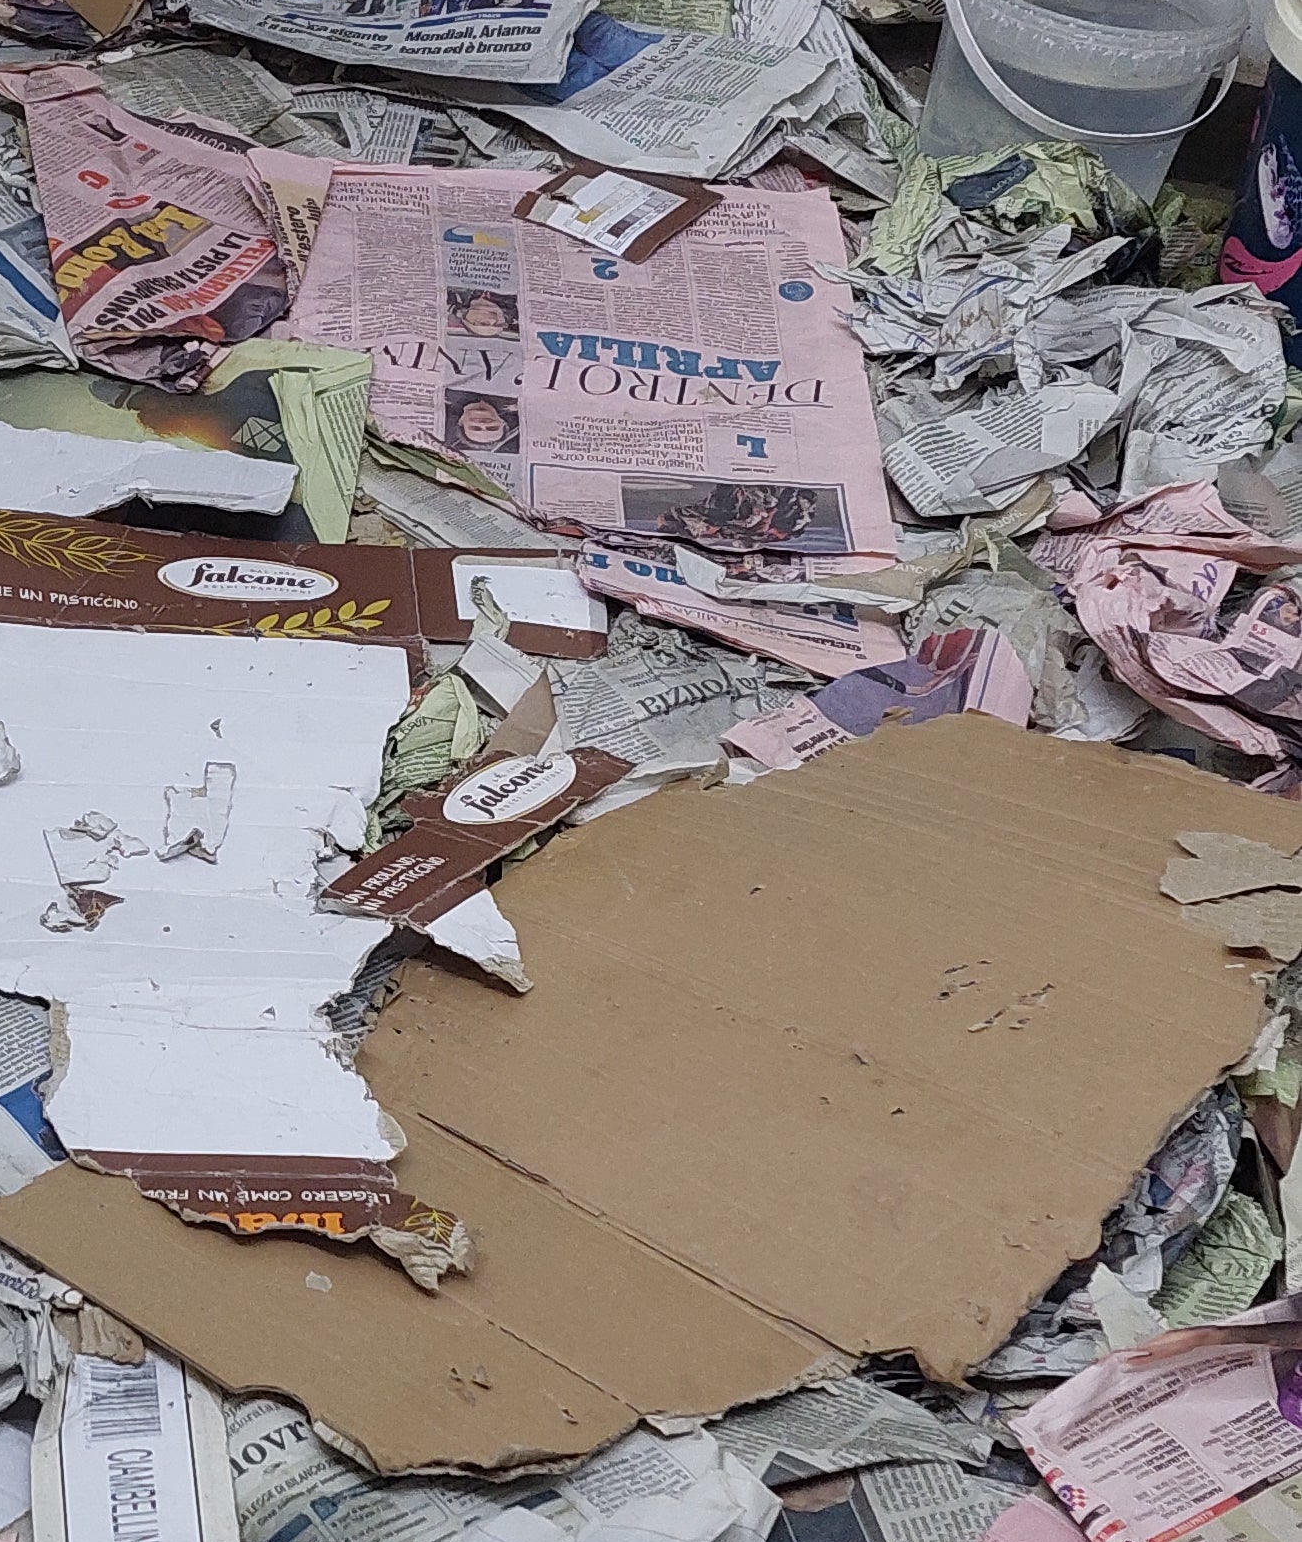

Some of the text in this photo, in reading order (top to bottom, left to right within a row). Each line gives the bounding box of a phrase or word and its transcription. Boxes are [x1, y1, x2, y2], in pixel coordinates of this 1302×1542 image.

[481, 24, 542, 38] Arianna
[477, 41, 533, 53] bronzo
[175, 245, 230, 285] PISTA
[591, 259, 620, 281] 2
[536, 331, 781, 383] APRILIA
[578, 363, 826, 406] DENTRO
[736, 434, 769, 459] L
[551, 453, 704, 471] Viaggio nel reparto corse
[185, 561, 316, 590] falcone
[18, 585, 44, 603] UN
[459, 759, 554, 820] falcone
[198, 1188, 229, 1203] UN
[236, 1188, 292, 1203] COME
[301, 1189, 392, 1205] LEGGERO
